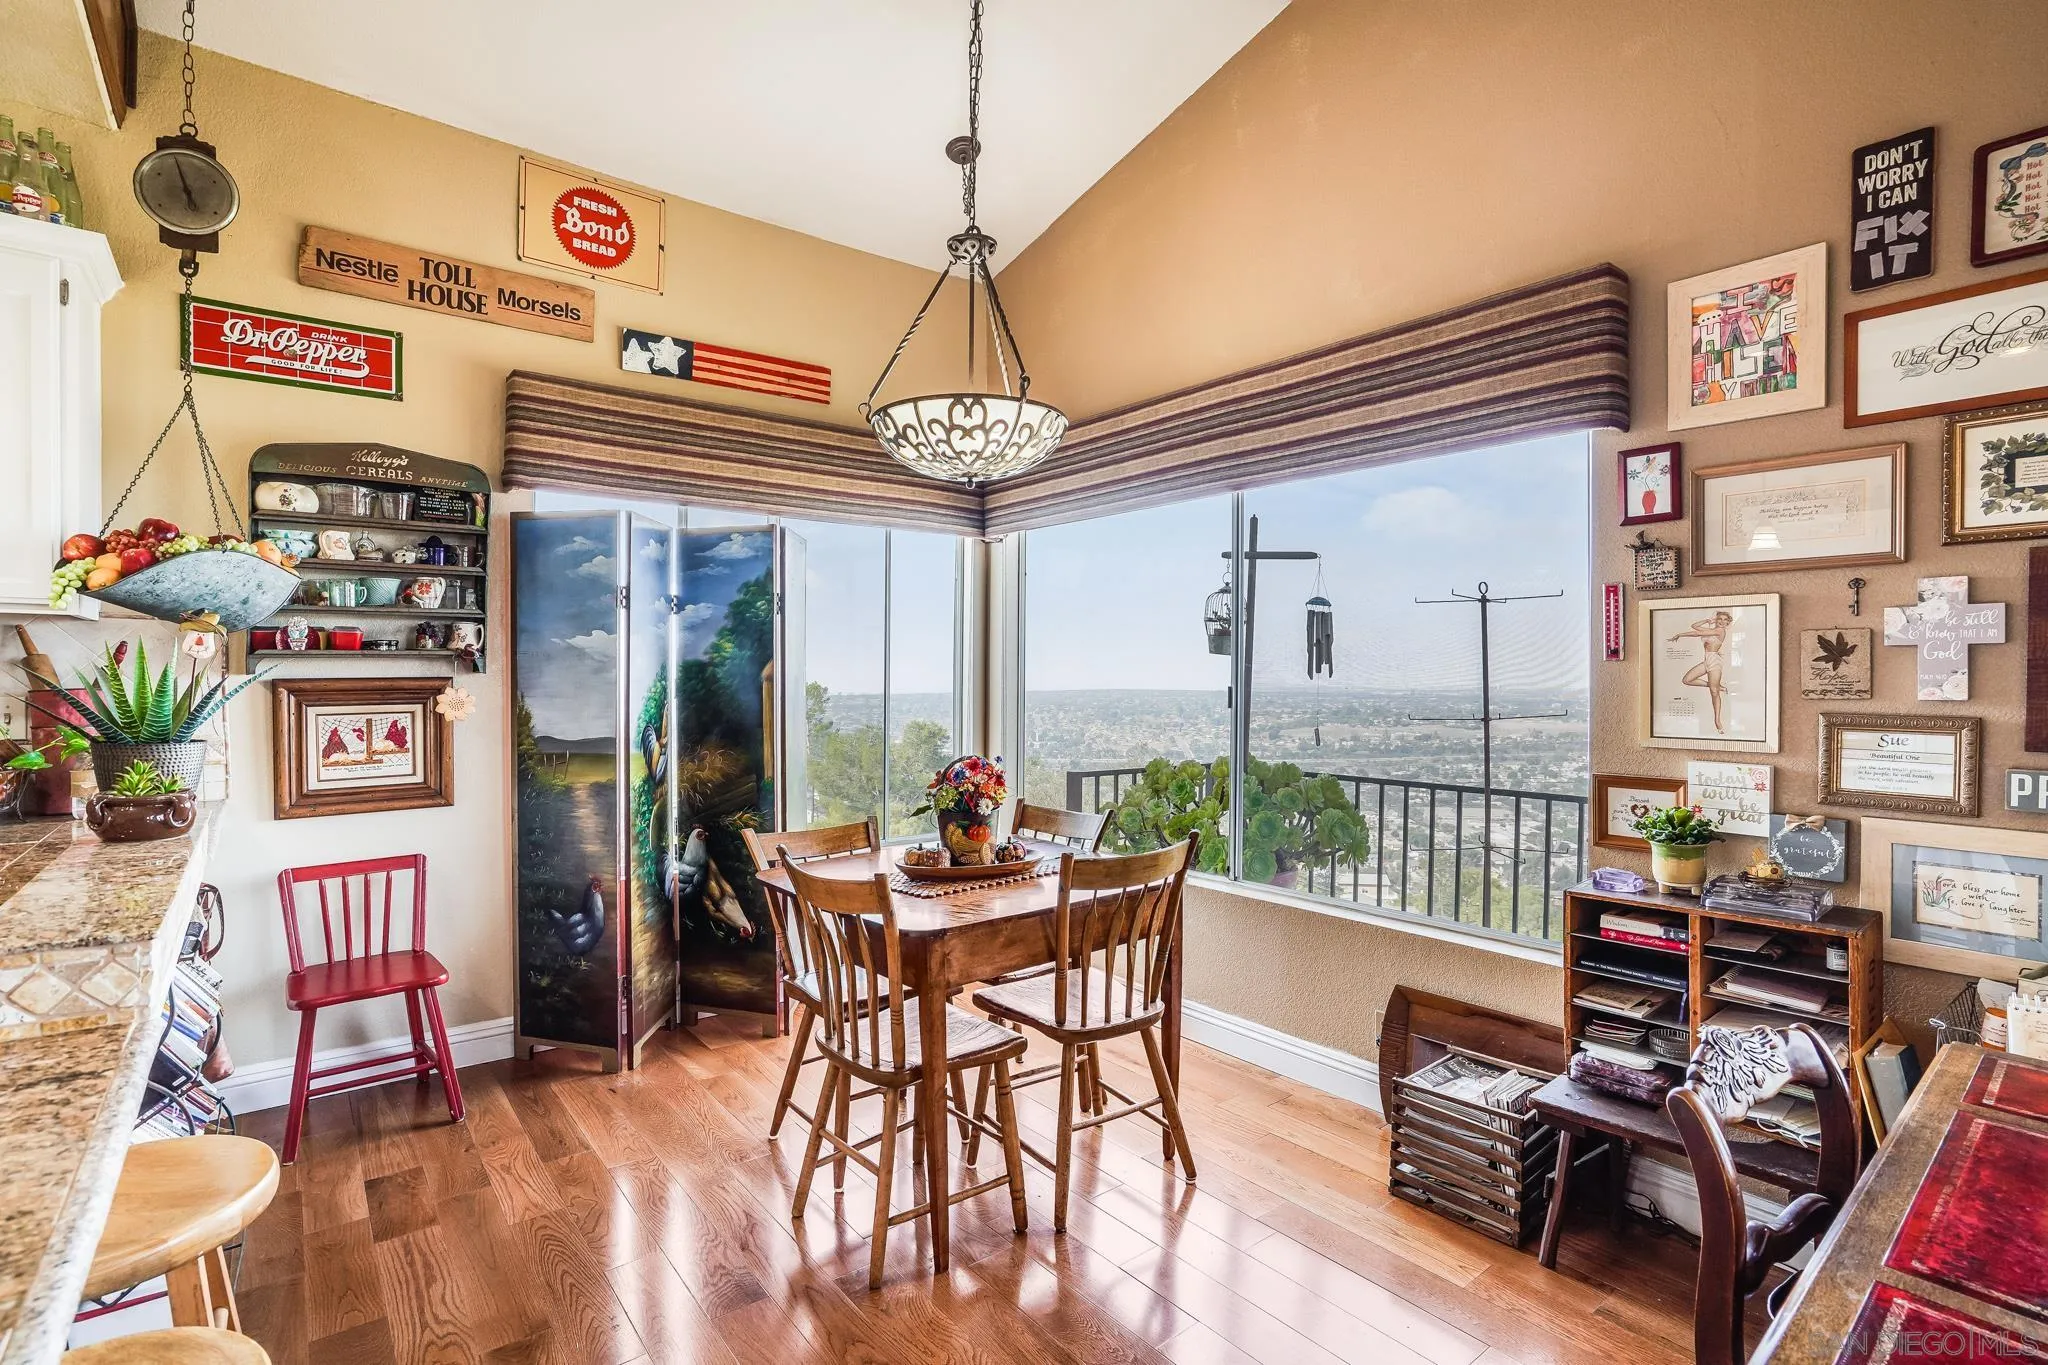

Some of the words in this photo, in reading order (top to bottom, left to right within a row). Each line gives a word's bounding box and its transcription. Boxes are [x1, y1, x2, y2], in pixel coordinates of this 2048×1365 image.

[1865, 139, 1923, 174] DON'T
[1858, 158, 1929, 195] WORRY
[573, 196, 618, 218] FRESH
[1866, 194, 1873, 213] I
[1878, 182, 1918, 209] CAN
[557, 203, 630, 245] Bond
[1854, 209, 1931, 252] FIX
[572, 237, 617, 258] BREAD
[1869, 242, 1919, 280] IT
[418, 257, 477, 290] TOLL
[407, 279, 489, 316] HOUSE
[497, 287, 582, 322] Morsels
[311, 331, 348, 344] DRINK
[271, 359, 295, 367] GOOD
[351, 449, 409, 467] Kellogg's
[277, 462, 338, 474] DELICIOUS
[346, 465, 413, 481] CEREALS
[420, 476, 469, 488] ANYTIME
[1944, 609, 1960, 626] be
[1963, 608, 1999, 626] still
[1925, 622, 1956, 641] know
[1959, 628, 1976, 638] THAT
[1980, 629, 1984, 638] I
[1987, 628, 1998, 638] AM
[1923, 640, 1964, 660] God
[1809, 669, 1849, 684] Hope
[1877, 734, 1911, 748] Sue
[1869, 752, 1903, 761] Beautiful
[1695, 771, 1747, 793] today
[1702, 786, 1740, 800] will
[1739, 797, 1760, 812] be
[1717, 809, 1766, 826] great
[1783, 846, 1832, 859] grateful
[1963, 882, 1980, 893] bless
[1985, 888, 1999, 896] our
[2000, 887, 2021, 898] home
[1968, 893, 1989, 902] with
[1961, 898, 1975, 907] love
[1989, 902, 2027, 916] laughter
